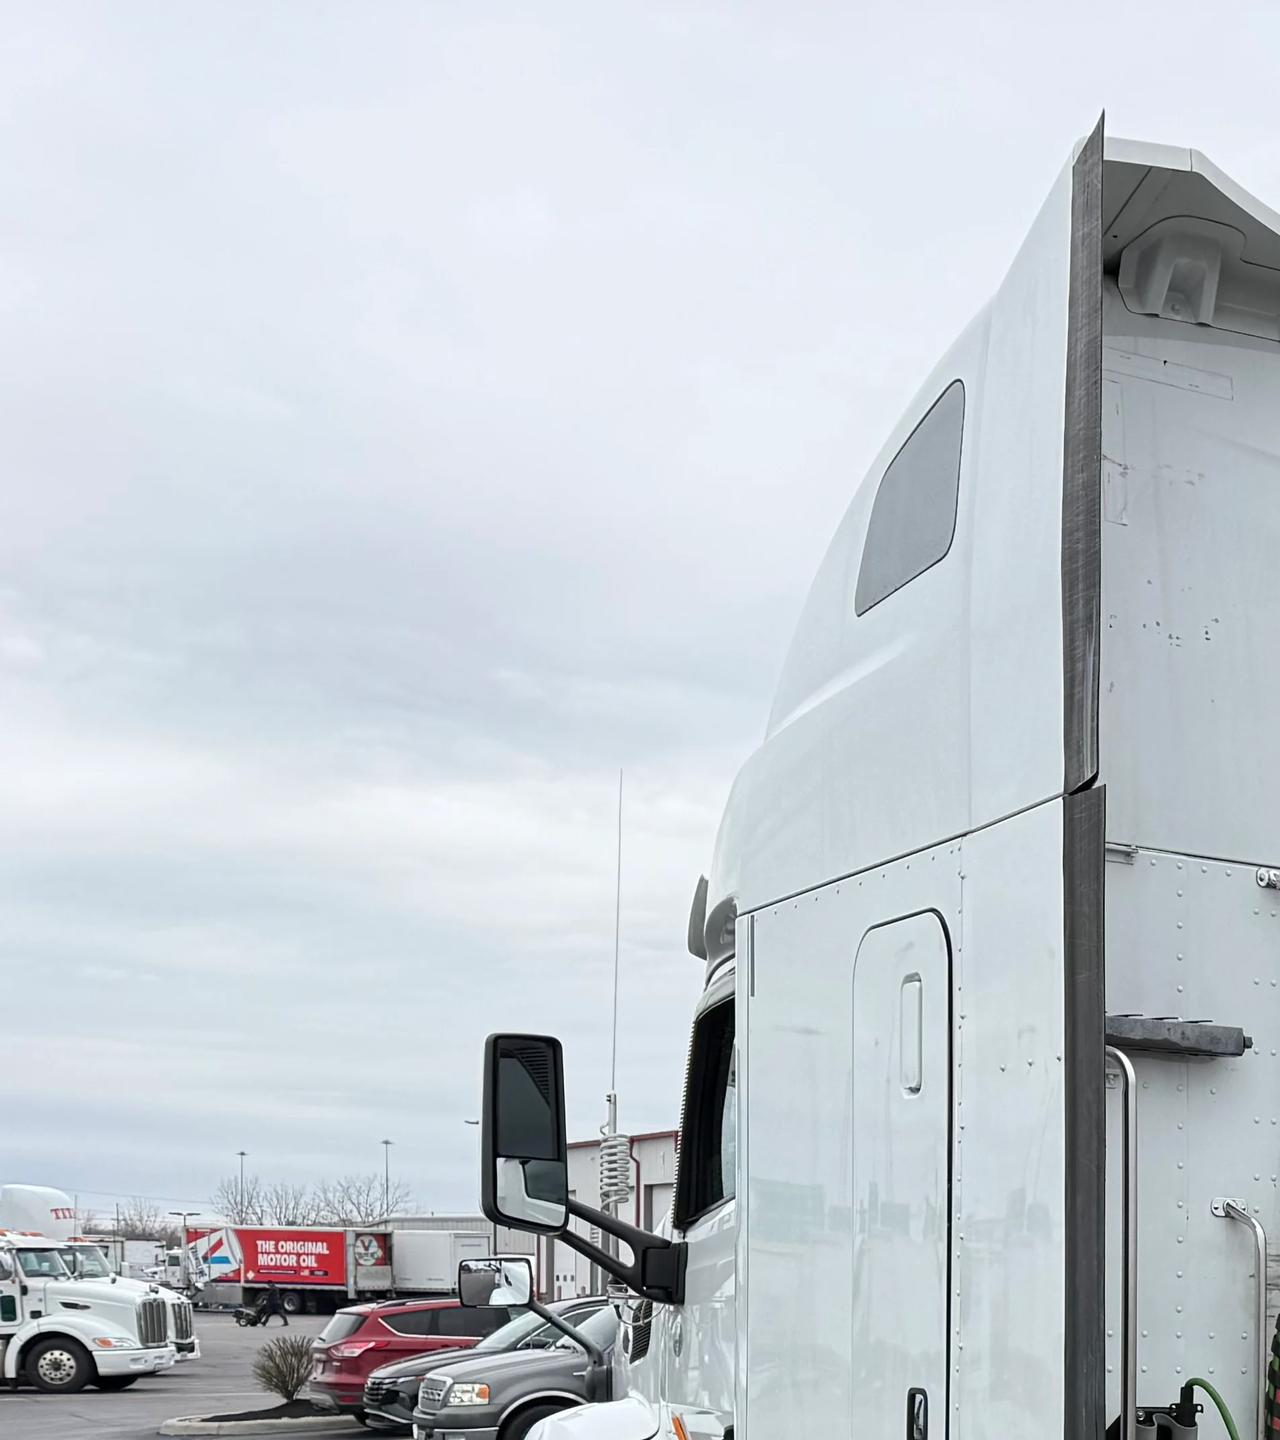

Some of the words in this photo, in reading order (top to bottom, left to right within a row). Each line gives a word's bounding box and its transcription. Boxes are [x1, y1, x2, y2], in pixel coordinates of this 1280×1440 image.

[256, 1240, 276, 1253] THE
[278, 1240, 330, 1254] ORIGINAL
[257, 1253, 297, 1266] MOTOR
[300, 1255, 318, 1267] OIL
